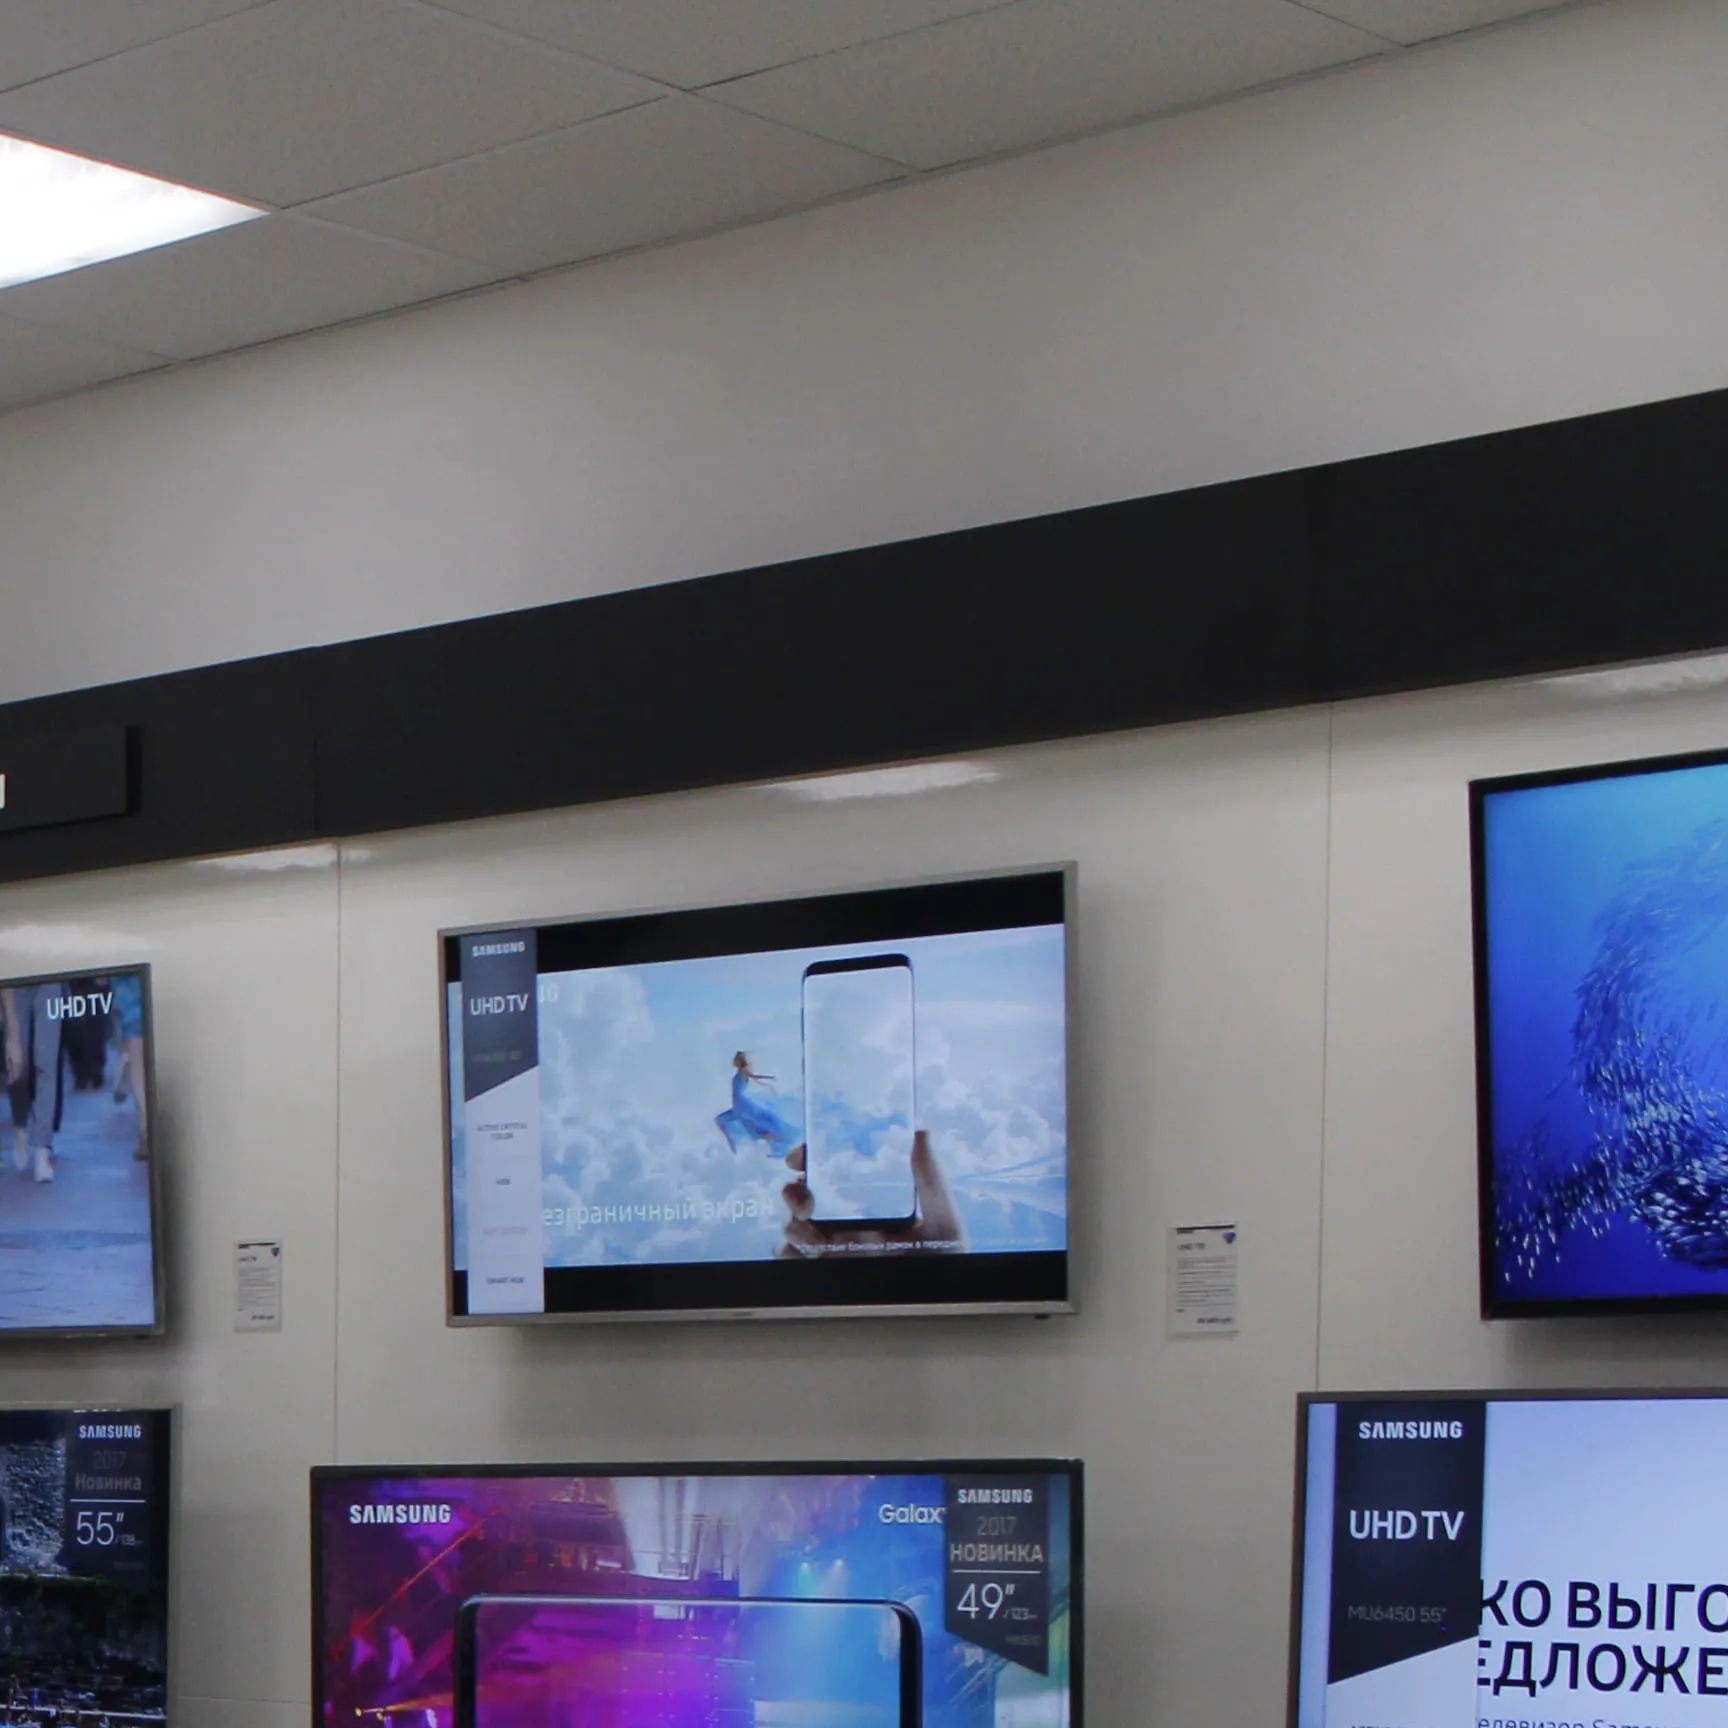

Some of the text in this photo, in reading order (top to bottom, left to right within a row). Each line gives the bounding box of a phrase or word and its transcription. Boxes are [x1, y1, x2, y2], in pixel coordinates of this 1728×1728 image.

[471, 941, 526, 957] SAMSUNG
[47, 991, 113, 1020] UHD TV
[470, 996, 505, 1016] UHD
[505, 993, 529, 1013] TV
[543, 1198, 776, 1230] езграничный экран
[78, 1424, 143, 1440] SAMSUNG
[1358, 1420, 1464, 1440] SAMSUNG
[92, 1451, 128, 1470] 2017
[74, 1472, 143, 1492] Новинка
[957, 1488, 1034, 1504] SAMSUNG
[349, 1504, 451, 1524] SAMSUNG
[878, 1502, 946, 1524] Galax
[976, 1516, 1018, 1537] 2017
[1348, 1509, 1465, 1541] UHD TV
[949, 1542, 1044, 1564] НОВИНКА
[956, 1582, 1016, 1620] 49"
[1347, 1605, 1416, 1622] MU6450
